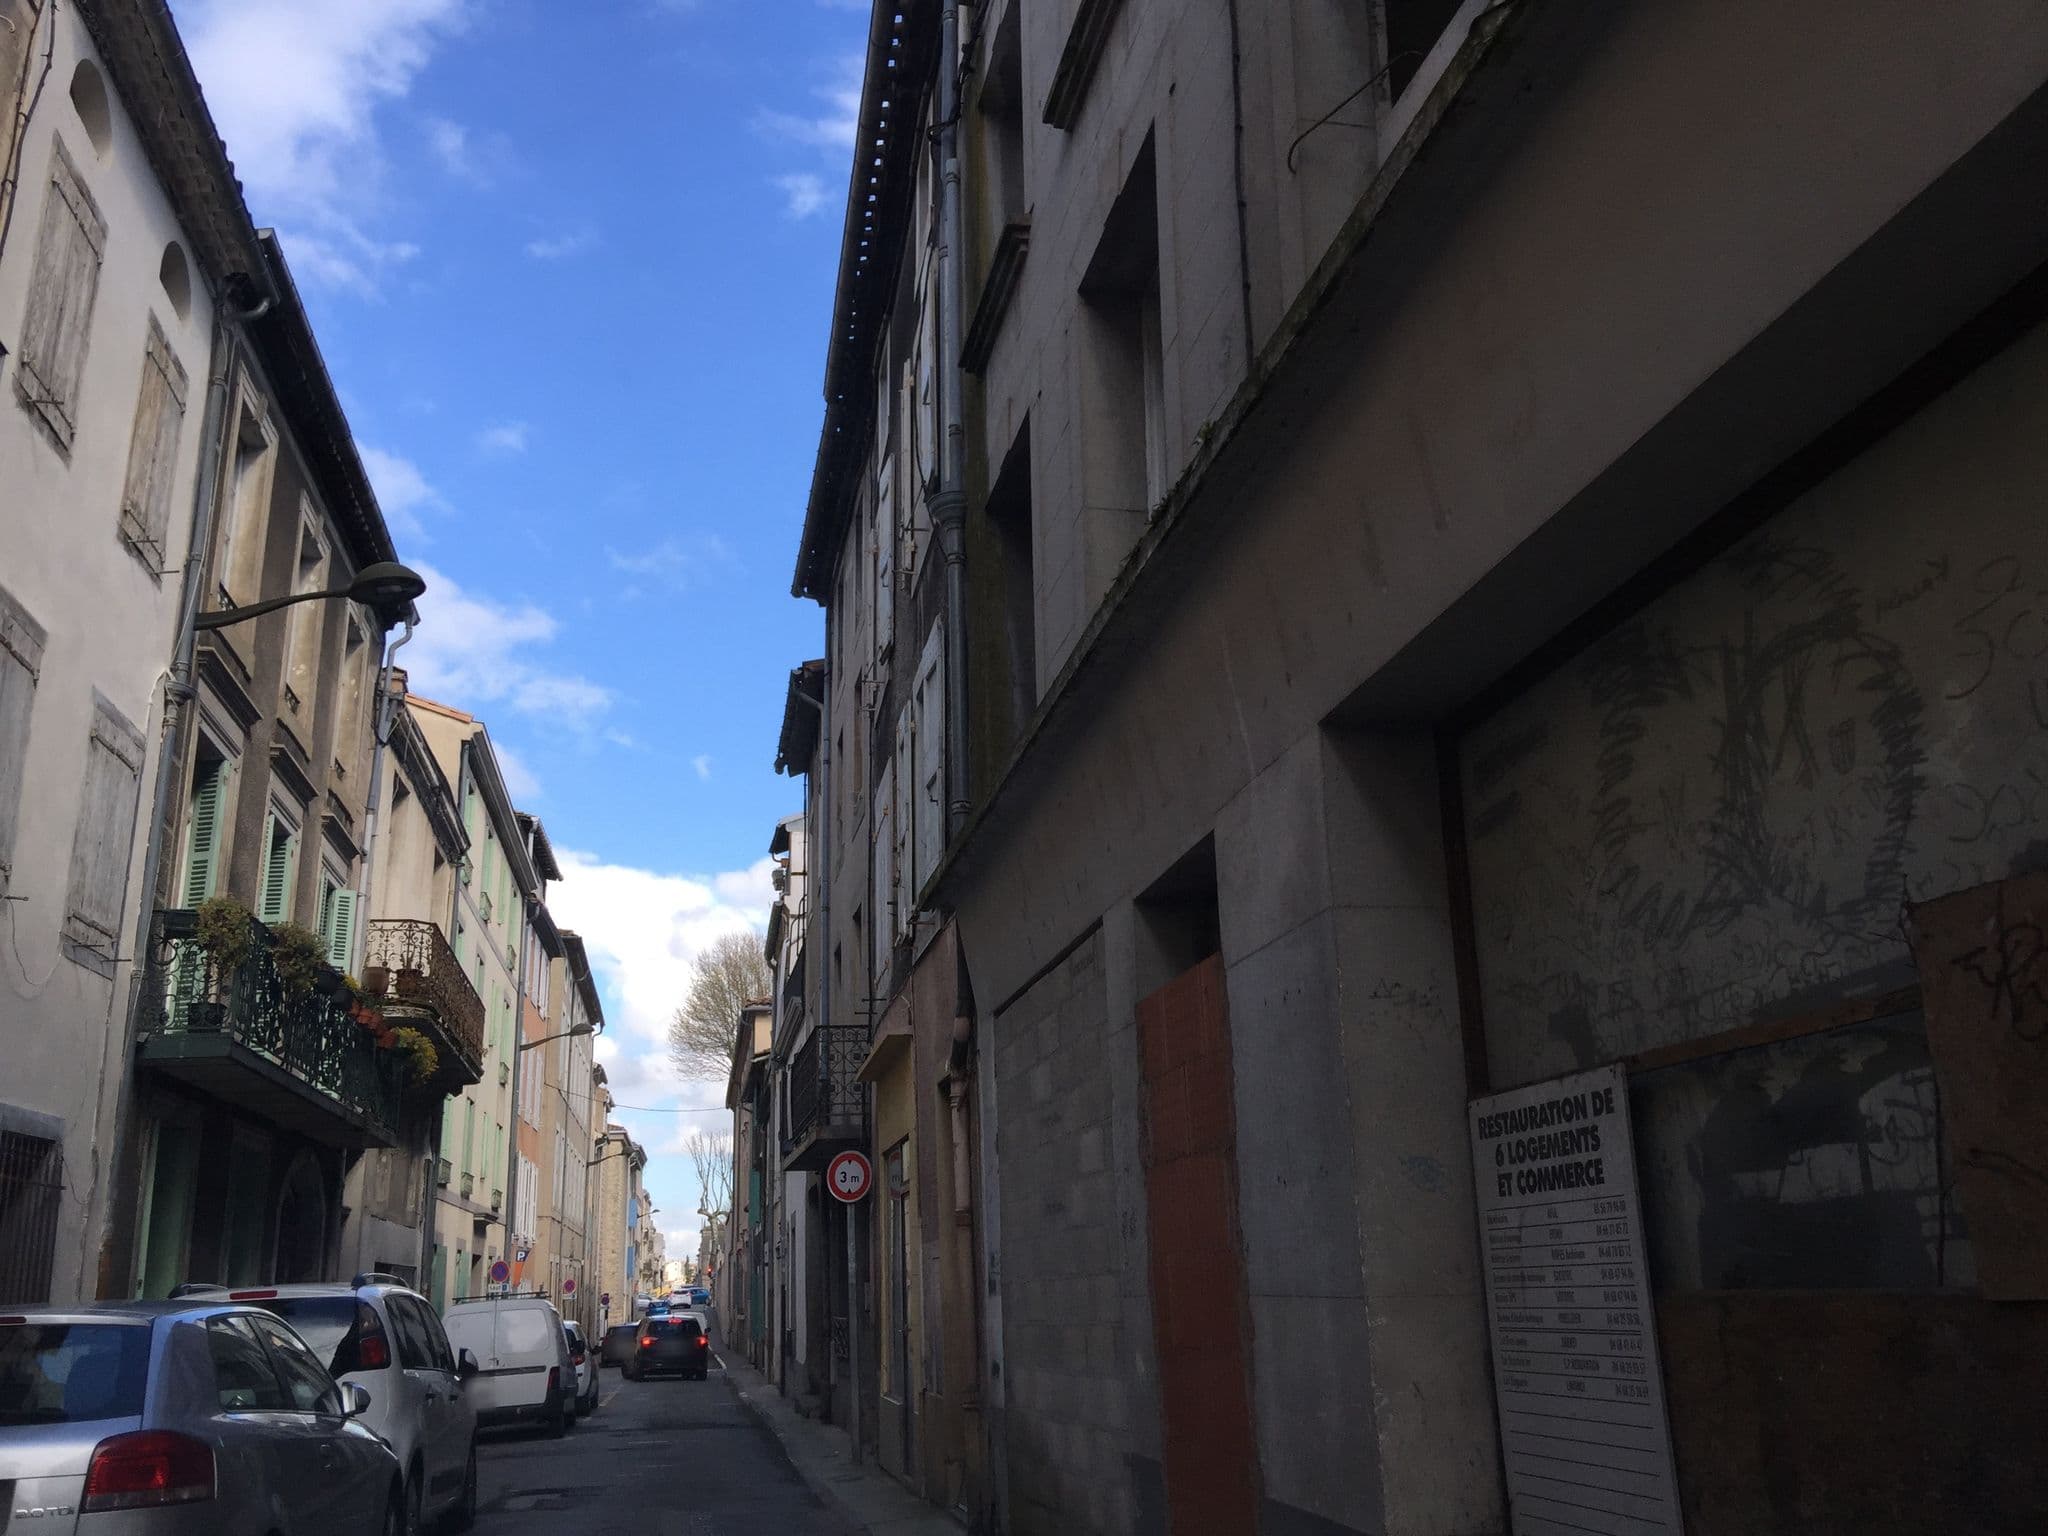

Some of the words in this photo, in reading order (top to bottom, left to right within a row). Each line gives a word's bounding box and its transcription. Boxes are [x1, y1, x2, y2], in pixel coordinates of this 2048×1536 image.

[1478, 1093, 1588, 1140] RESTAURATION
[1590, 1087, 1615, 1117] DE
[1495, 1143, 1505, 1168] 6
[1507, 1124, 1601, 1165] LOGEMENTS
[840, 1171, 847, 1183] 3
[850, 1175, 860, 1183] m
[1497, 1172, 1513, 1197] ET
[1517, 1158, 1605, 1196] COMMERCE
[517, 1251, 526, 1261] P
